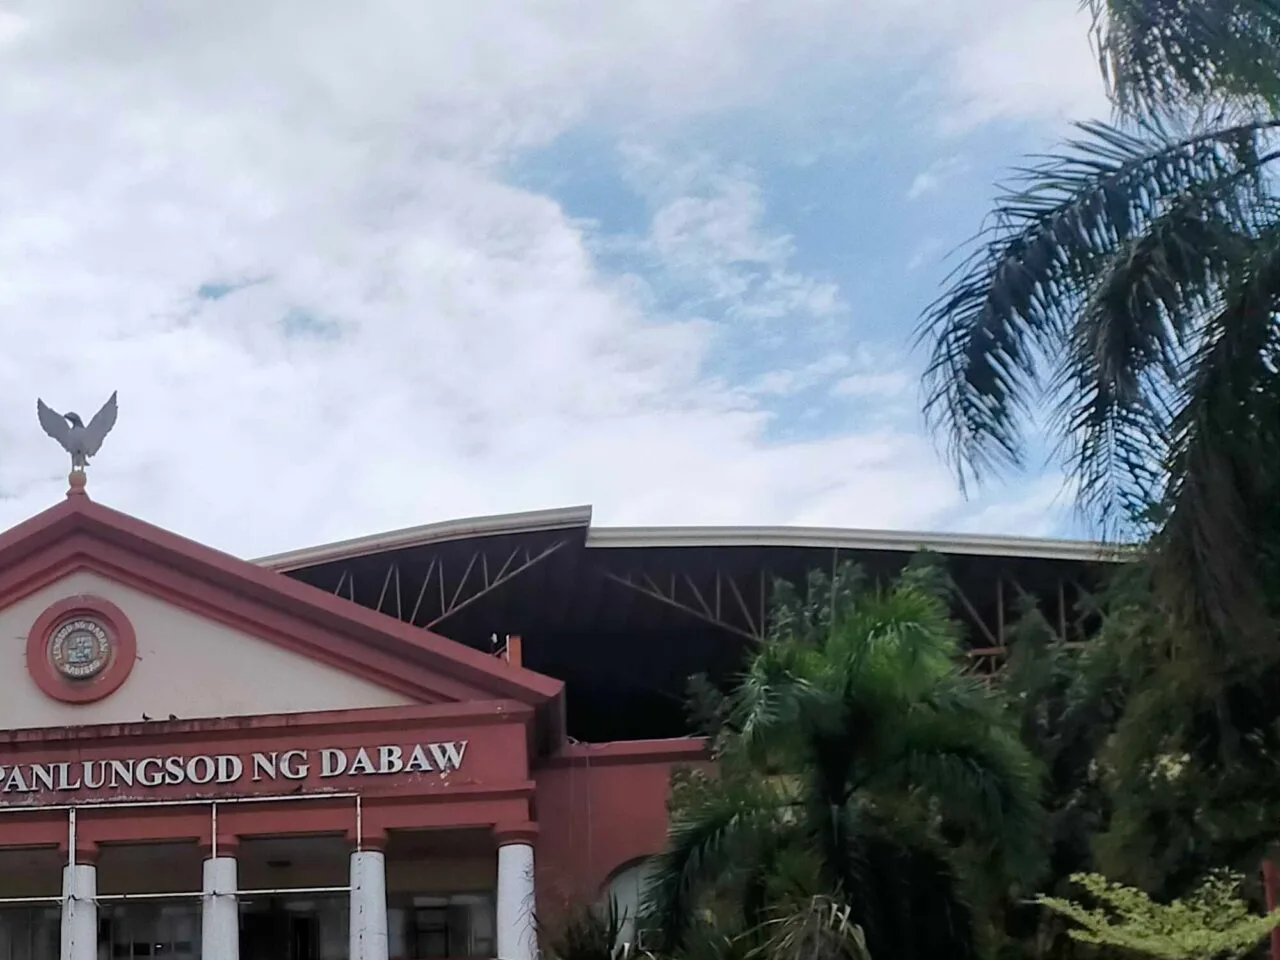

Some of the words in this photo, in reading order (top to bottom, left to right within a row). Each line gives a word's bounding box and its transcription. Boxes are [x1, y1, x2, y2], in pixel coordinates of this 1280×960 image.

[74, 620, 86, 630] NG
[252, 750, 310, 780] NG
[320, 740, 468, 777] DABAW
